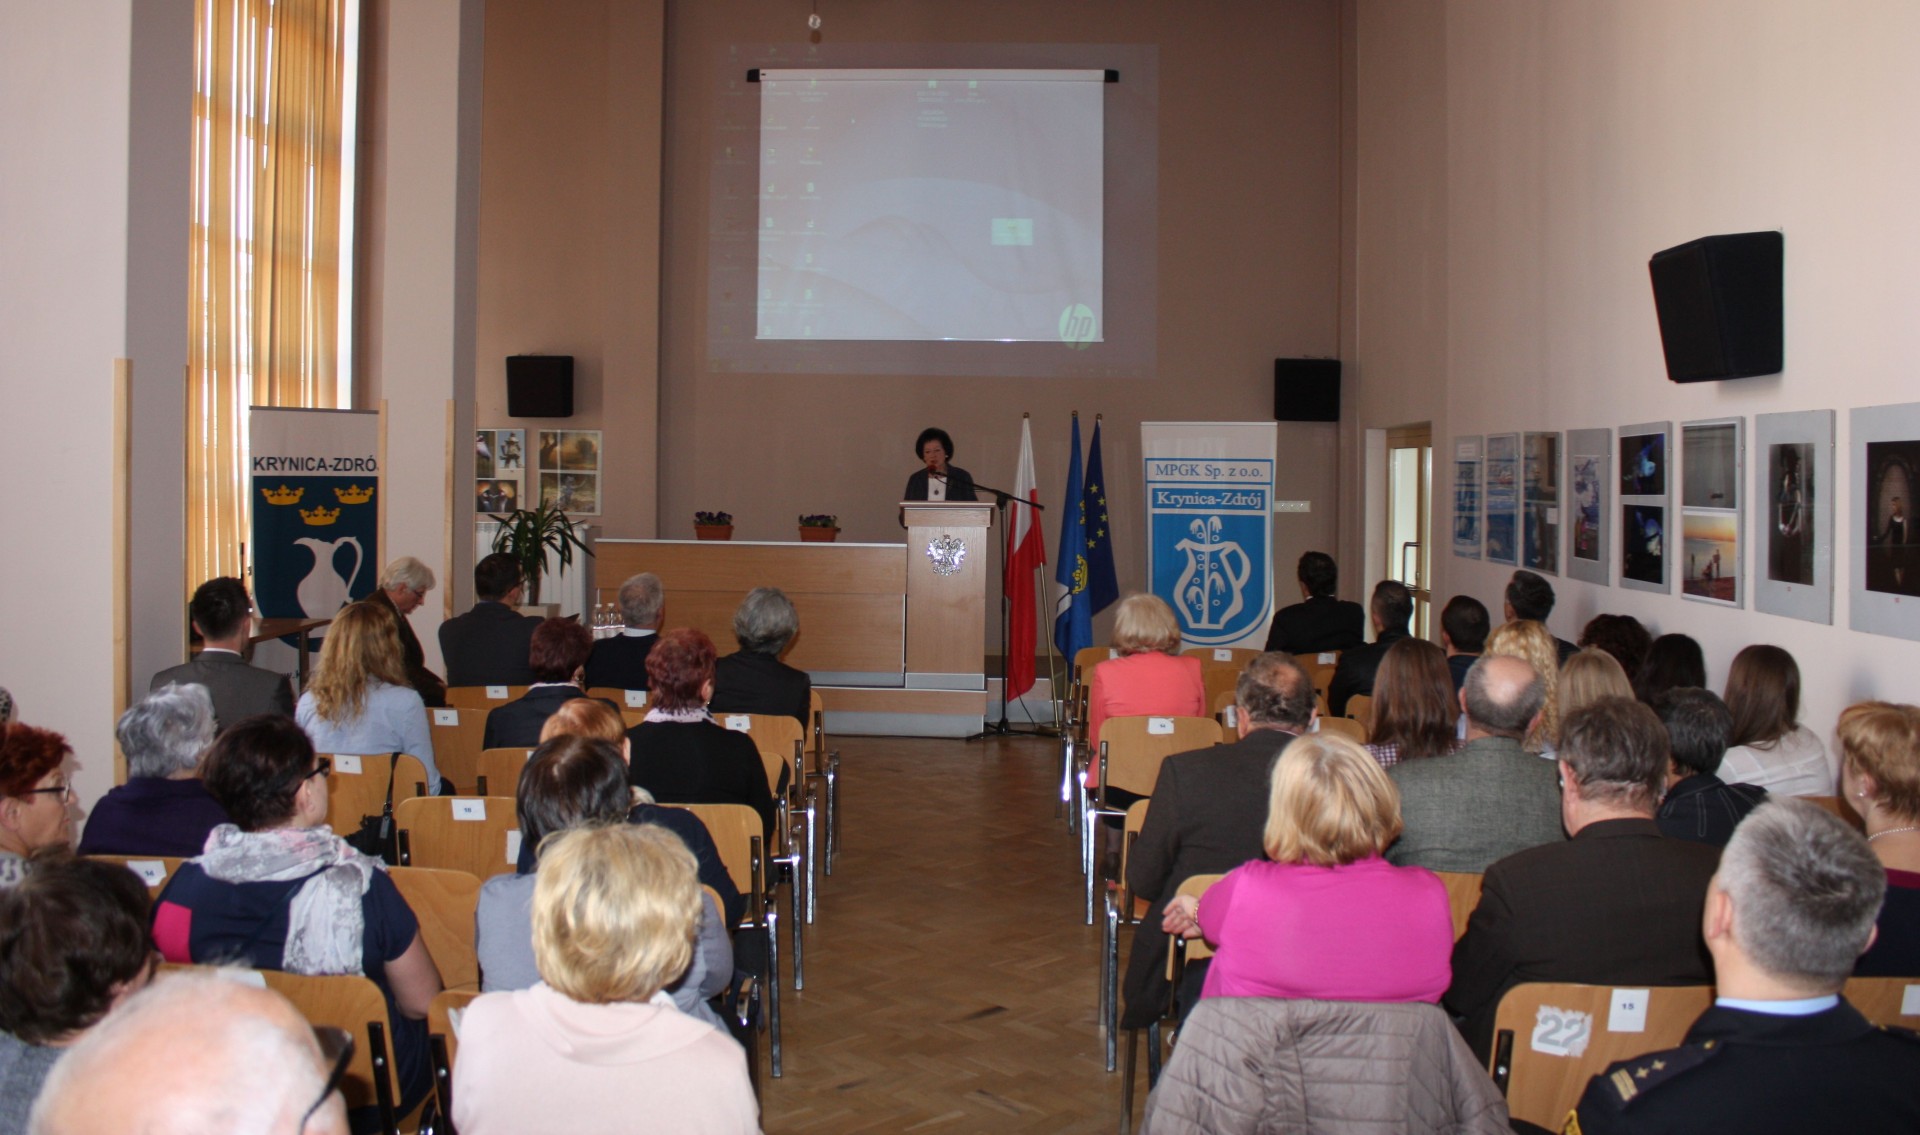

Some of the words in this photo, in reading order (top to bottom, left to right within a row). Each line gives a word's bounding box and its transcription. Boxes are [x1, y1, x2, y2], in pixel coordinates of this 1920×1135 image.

[1063, 303, 1092, 350] hp
[253, 455, 379, 472] KRYNICA-ZDRÓ
[1155, 464, 1200, 477] MPGK
[1204, 464, 1225, 480] Sp.
[1228, 468, 1236, 477] z
[1239, 468, 1264, 477] o.o.
[1157, 491, 1262, 509] Krynica-Zdrój
[1622, 1002, 1634, 1010] 15
[1537, 1014, 1587, 1048] 22
